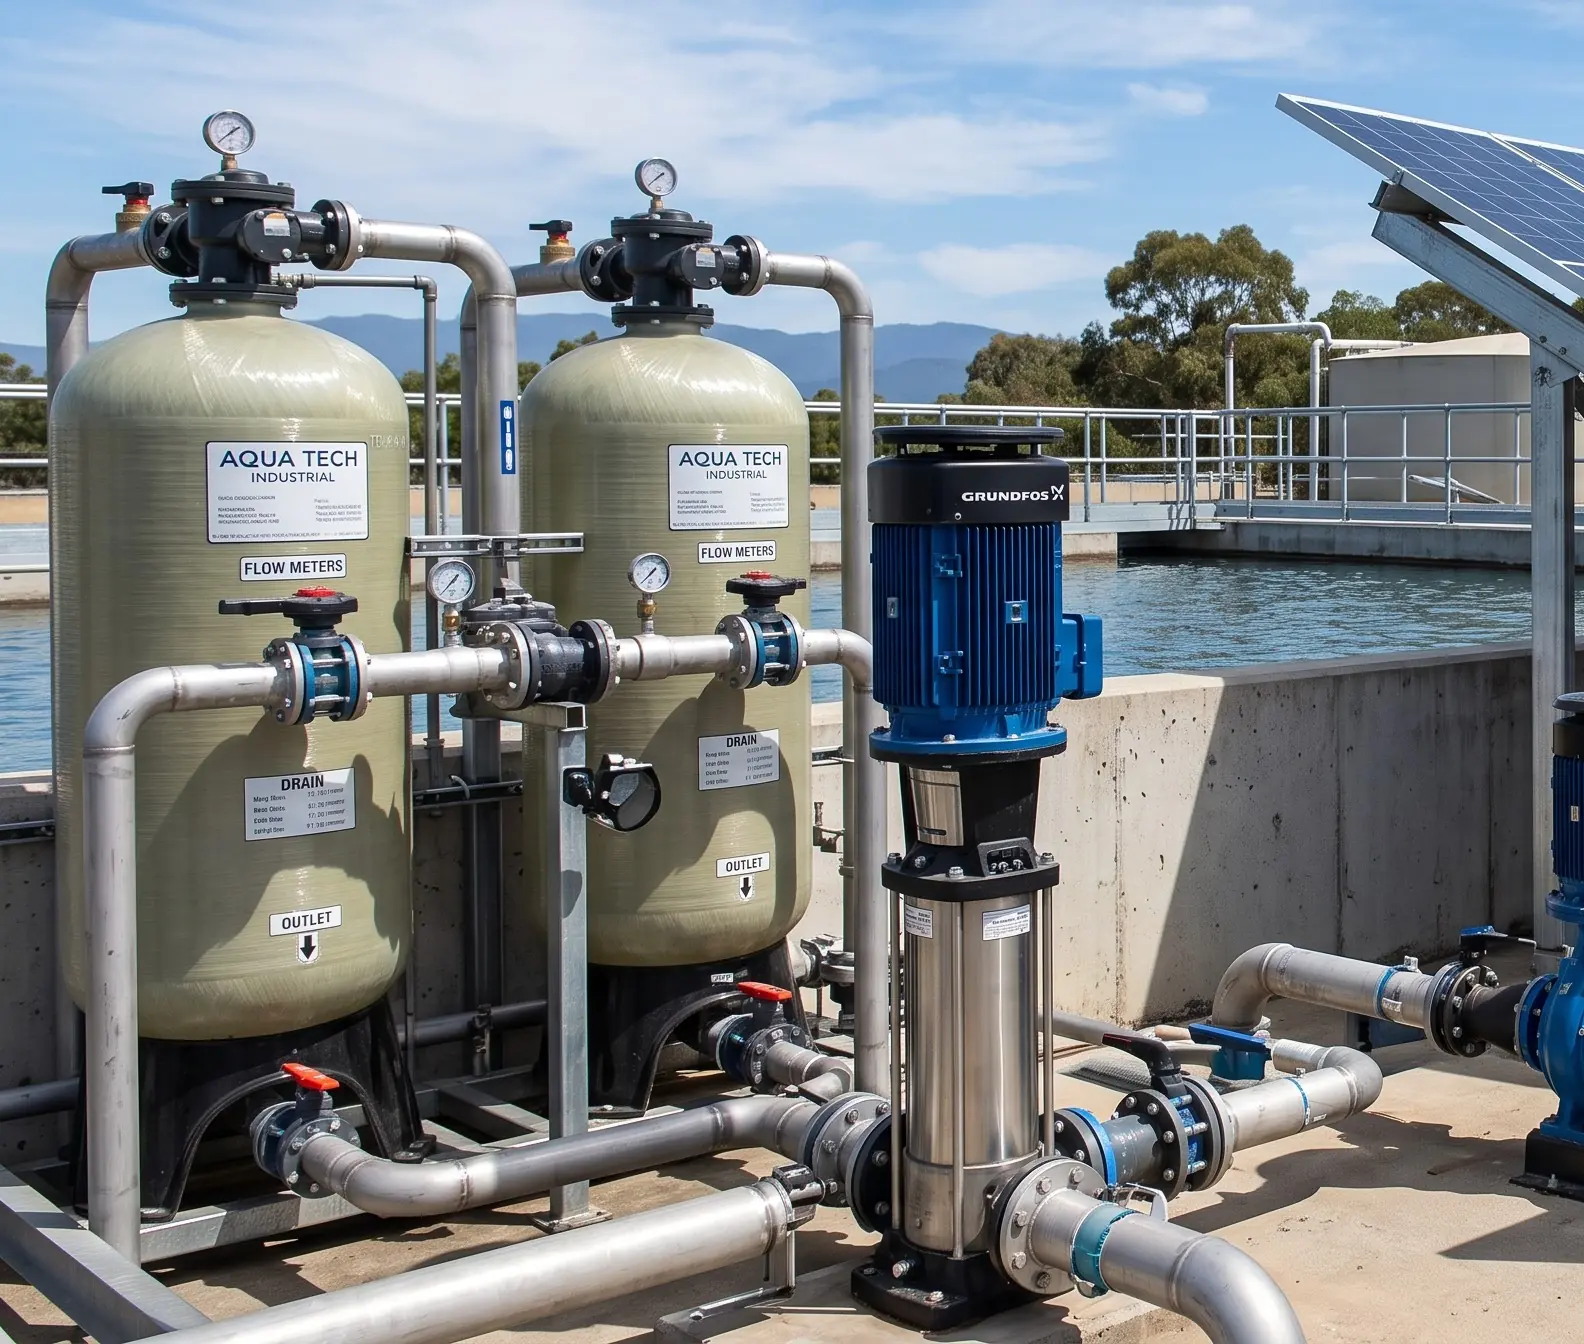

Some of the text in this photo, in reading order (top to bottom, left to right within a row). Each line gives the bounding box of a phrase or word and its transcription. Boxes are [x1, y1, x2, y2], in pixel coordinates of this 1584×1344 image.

[219, 450, 357, 468] AQUA TECH
[678, 451, 781, 467] AQUA TECH
[251, 472, 335, 483] INDUSTRIAL
[706, 470, 767, 480] INDUSTRIAL
[961, 491, 1049, 502] GRUNDFOS
[701, 545, 774, 559] FLOW METERS
[244, 560, 343, 575] FLOW METERS
[726, 734, 757, 748] DRAIN
[281, 774, 324, 791] DRAIN
[725, 856, 763, 872] OUTLET
[282, 910, 332, 930] OUTLET
